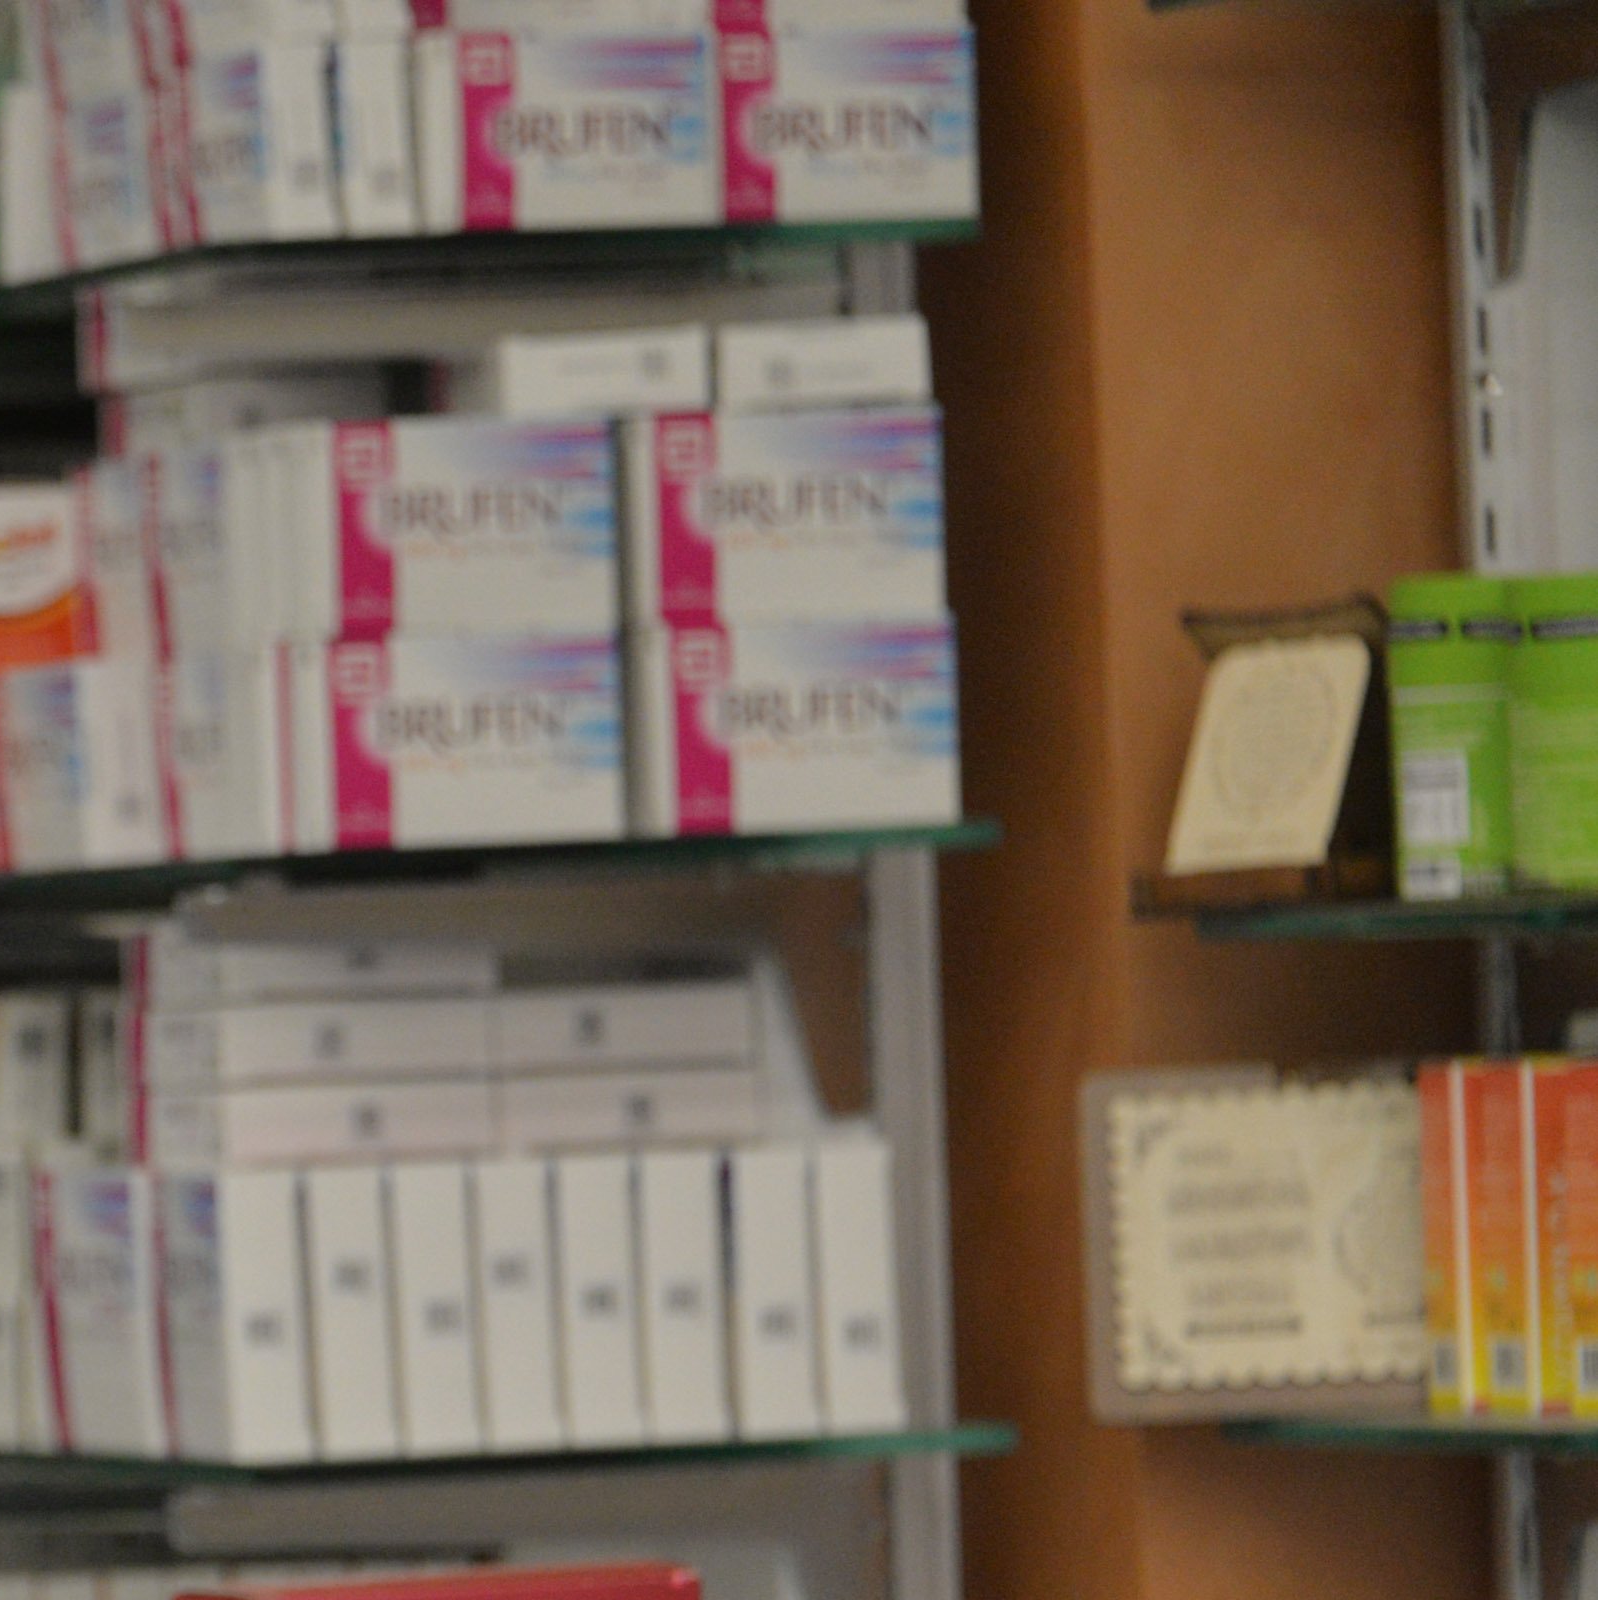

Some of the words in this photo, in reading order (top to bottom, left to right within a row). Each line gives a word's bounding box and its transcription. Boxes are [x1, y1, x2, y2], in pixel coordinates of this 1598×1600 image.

[492, 100, 670, 156] BRUFEN
[749, 97, 934, 154] BRUFEN
[381, 480, 564, 536] BRUFEN
[702, 473, 890, 530] BRUFEN
